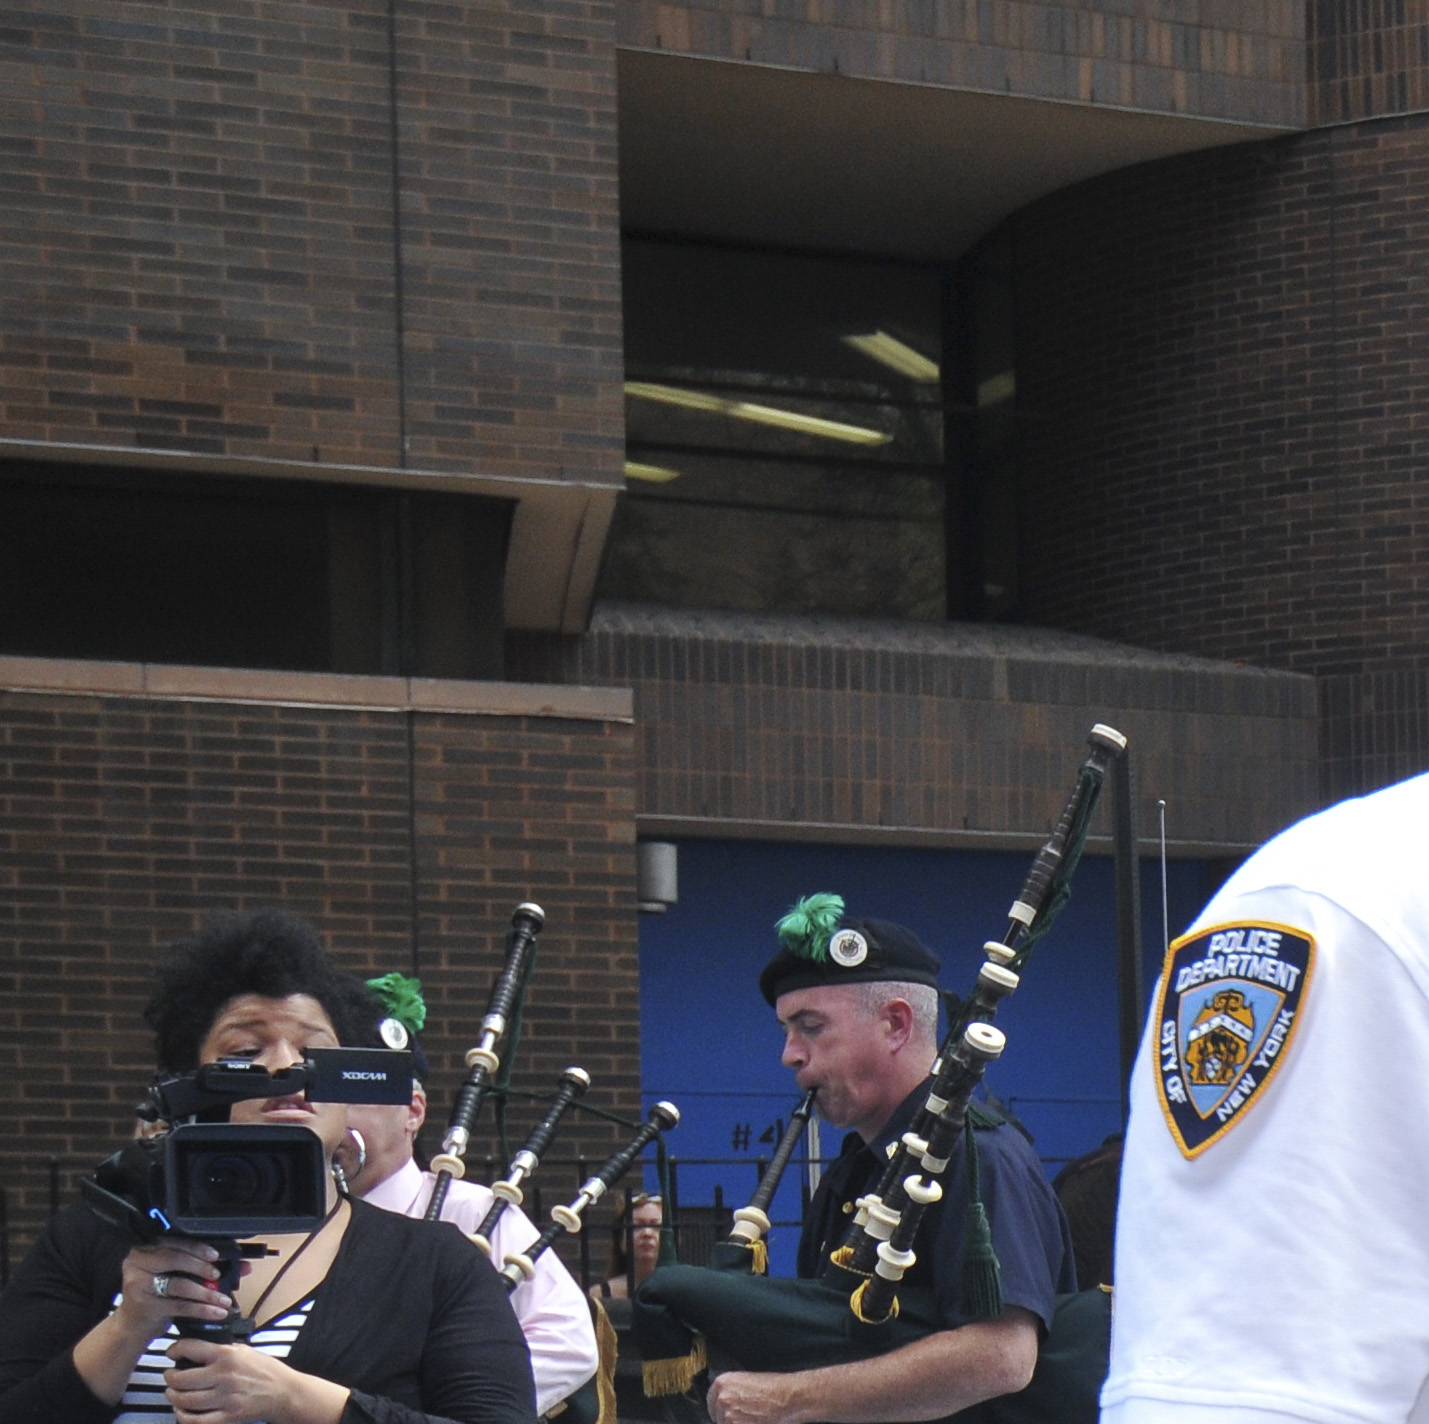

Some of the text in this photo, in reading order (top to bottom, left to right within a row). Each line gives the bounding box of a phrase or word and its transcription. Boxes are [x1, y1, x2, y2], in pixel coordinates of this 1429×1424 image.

[1208, 929, 1283, 958] POLICE
[1174, 955, 1301, 993] DEPARTMENT
[342, 1071, 387, 1081] XDCAM
[1161, 1019, 1188, 1105] CITY OF
[1216, 1008, 1296, 1123] NEW YORK
